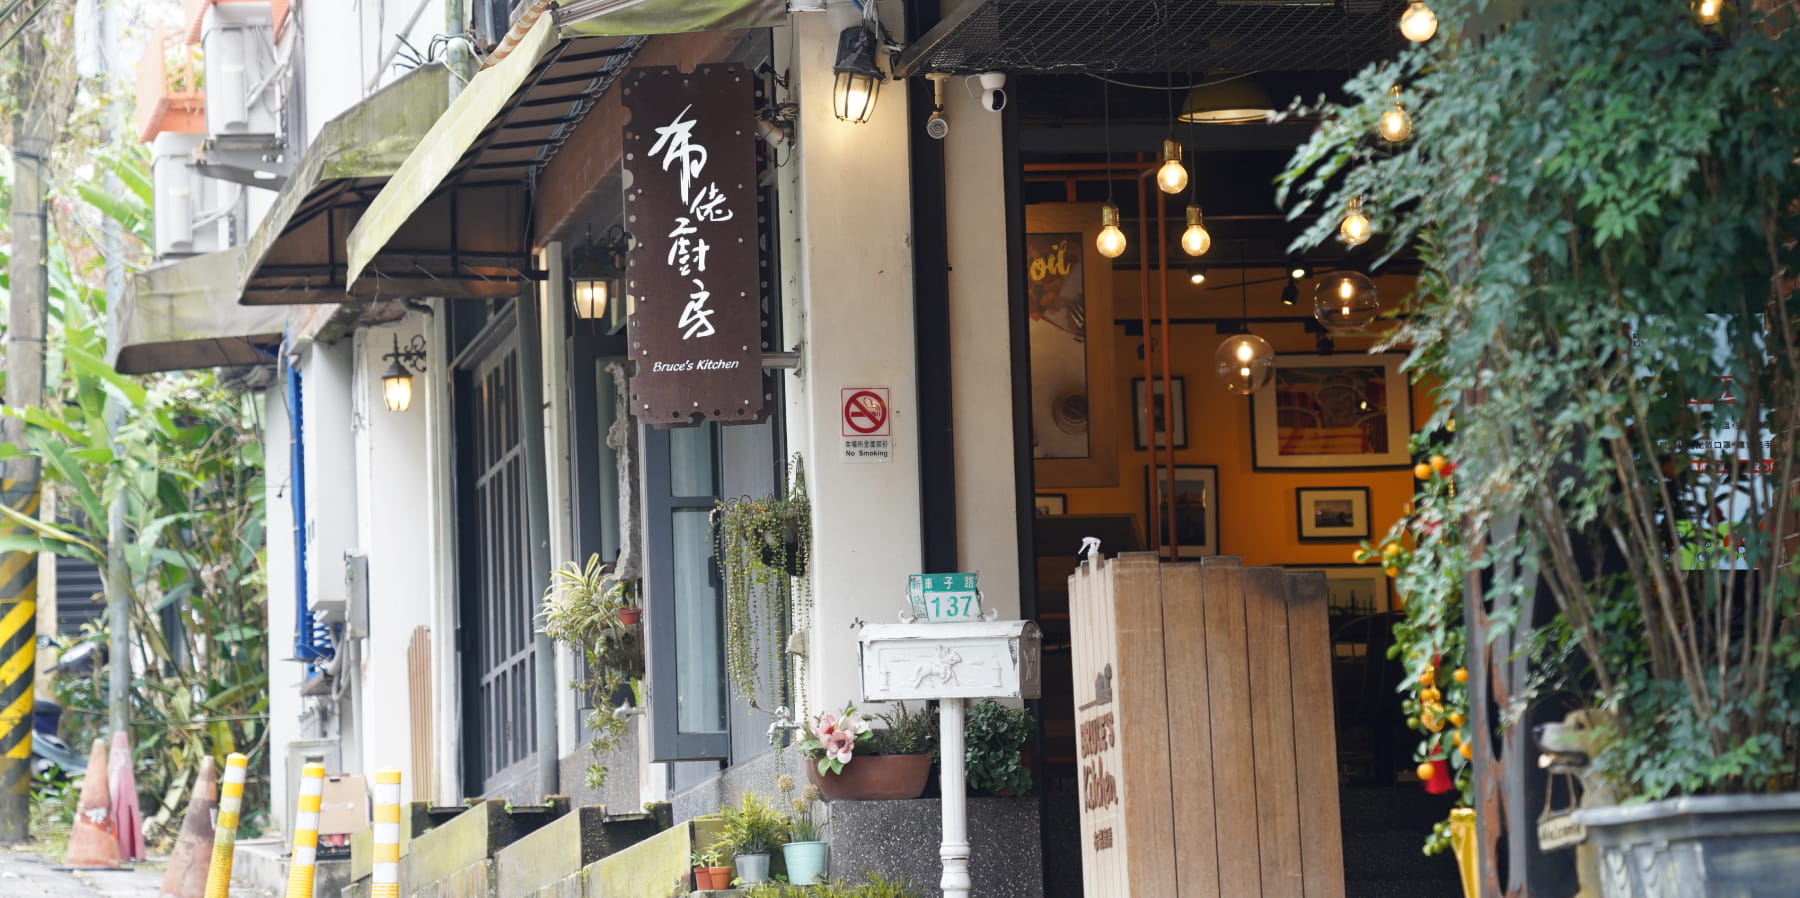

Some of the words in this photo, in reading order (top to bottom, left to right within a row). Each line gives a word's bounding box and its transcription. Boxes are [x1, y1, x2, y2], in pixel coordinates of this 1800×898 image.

[647, 103, 734, 341] 布佬廚房
[1030, 239, 1071, 281] oil
[652, 359, 694, 373] Bruce's
[696, 358, 739, 371] Kitchen
[924, 576, 975, 589] 車子路
[930, 596, 972, 618] 137
